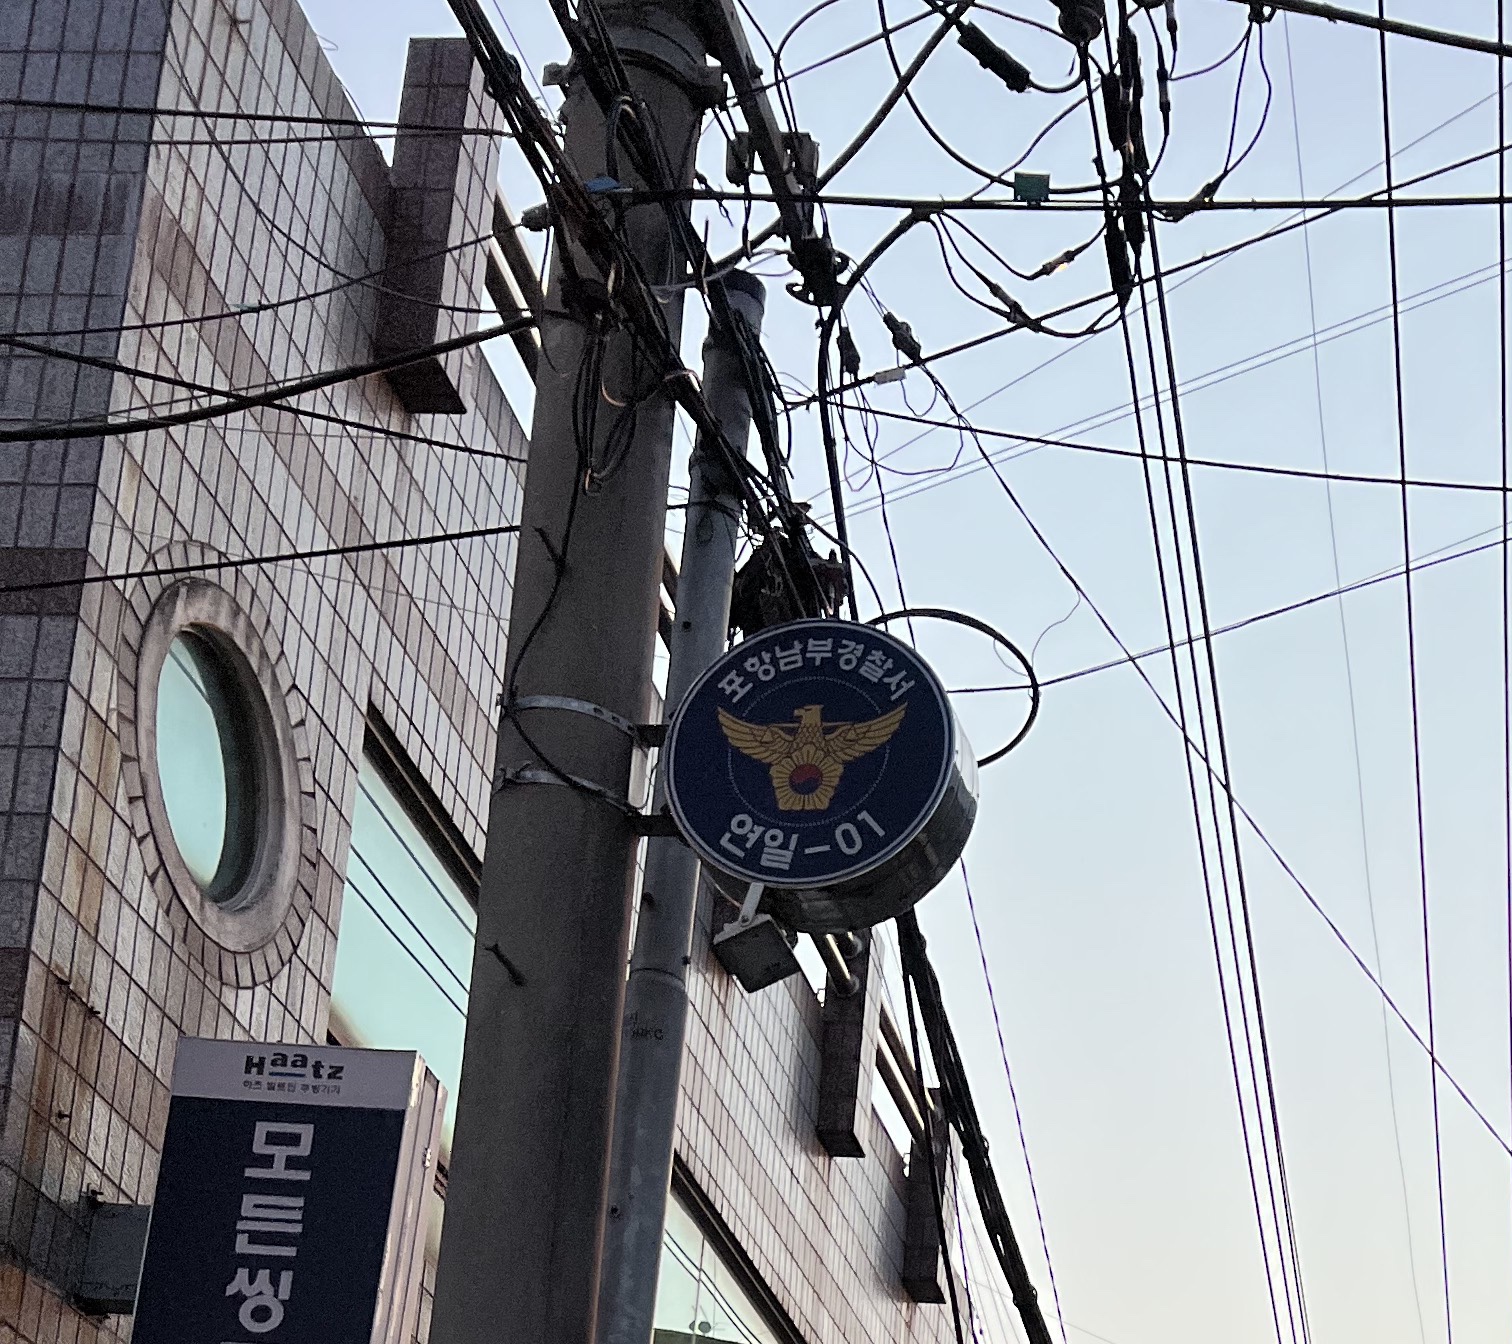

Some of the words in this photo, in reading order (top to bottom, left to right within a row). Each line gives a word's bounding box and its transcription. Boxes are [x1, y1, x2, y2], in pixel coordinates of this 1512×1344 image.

[717, 638, 915, 703] 포항남부경찰서
[719, 810, 886, 870] 연일-01
[244, 1052, 345, 1081] Haatz
